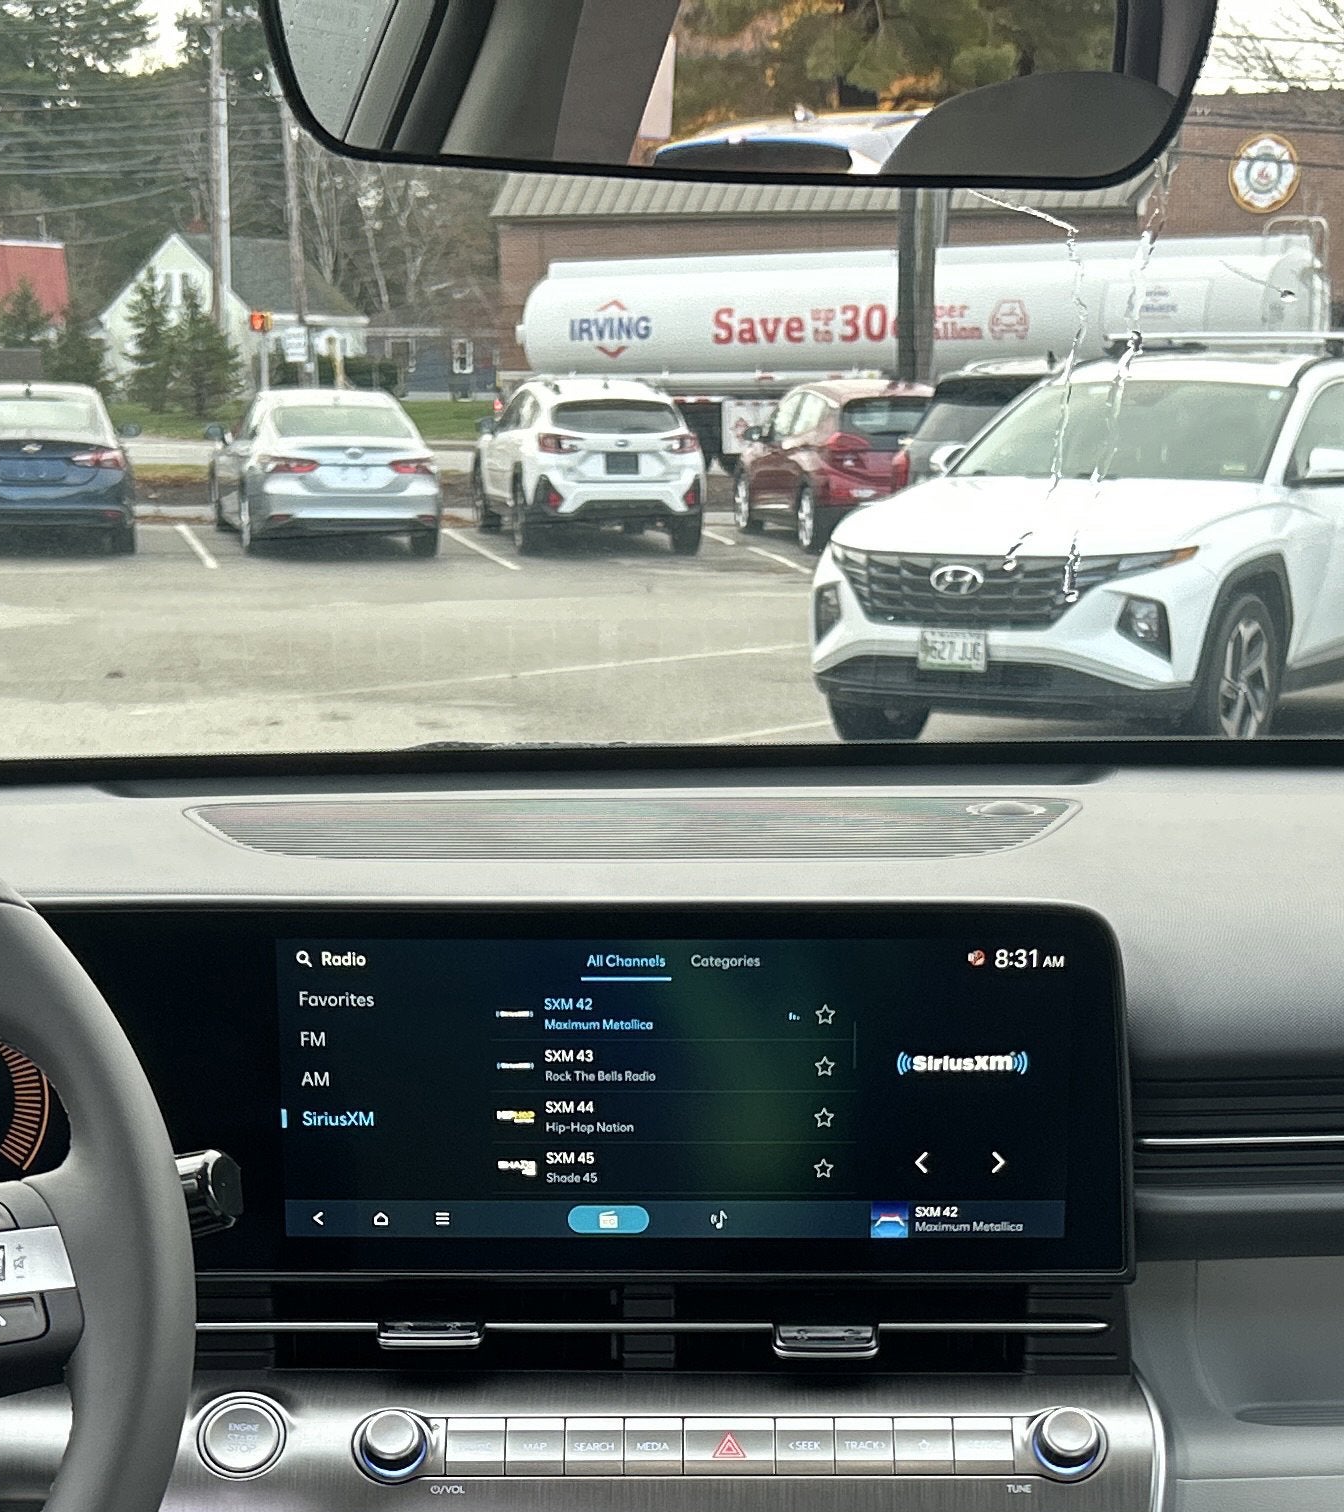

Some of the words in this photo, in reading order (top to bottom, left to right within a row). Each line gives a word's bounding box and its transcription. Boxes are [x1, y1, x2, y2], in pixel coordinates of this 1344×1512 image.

[811, 309, 835, 324] up
[570, 316, 652, 341] IRVING
[712, 307, 805, 345] Save
[813, 324, 833, 343] to
[321, 951, 366, 967] Radio
[586, 954, 603, 968] All
[605, 954, 666, 968] Channels
[690, 954, 761, 970] Categories
[994, 949, 1038, 968] 8:31
[1043, 956, 1065, 968] AM
[298, 991, 375, 1008] Favorites
[544, 998, 573, 1011] SXM
[575, 998, 593, 1011] 42
[544, 1019, 600, 1030] Maximum
[602, 1019, 654, 1030] Metallica
[300, 1031, 326, 1047] FM
[544, 1049, 574, 1063] SXM
[576, 1049, 594, 1063] 43
[301, 1072, 330, 1087] AM
[545, 1070, 572, 1082] Rock
[574, 1070, 596, 1082] The
[597, 1070, 623, 1082] Bells
[624, 1070, 656, 1082] Radio
[545, 1101, 575, 1114] SXM
[576, 1101, 594, 1114] 44
[302, 1110, 374, 1128] SiriusXM
[545, 1122, 595, 1135] Hip-Hop
[596, 1122, 634, 1133] Nation
[546, 1151, 575, 1165] SXM
[577, 1151, 595, 1165] 45
[546, 1172, 581, 1184] Shade
[582, 1172, 598, 1184] 45
[915, 1206, 941, 1218] SXM
[942, 1206, 959, 1218] 42
[915, 1221, 970, 1232] Maximum
[972, 1221, 1024, 1232] Metallica
[574, 1442, 615, 1451] SEARCH
[635, 1442, 669, 1451] MEDIA
[1006, 1483, 1032, 1494] TUNE
